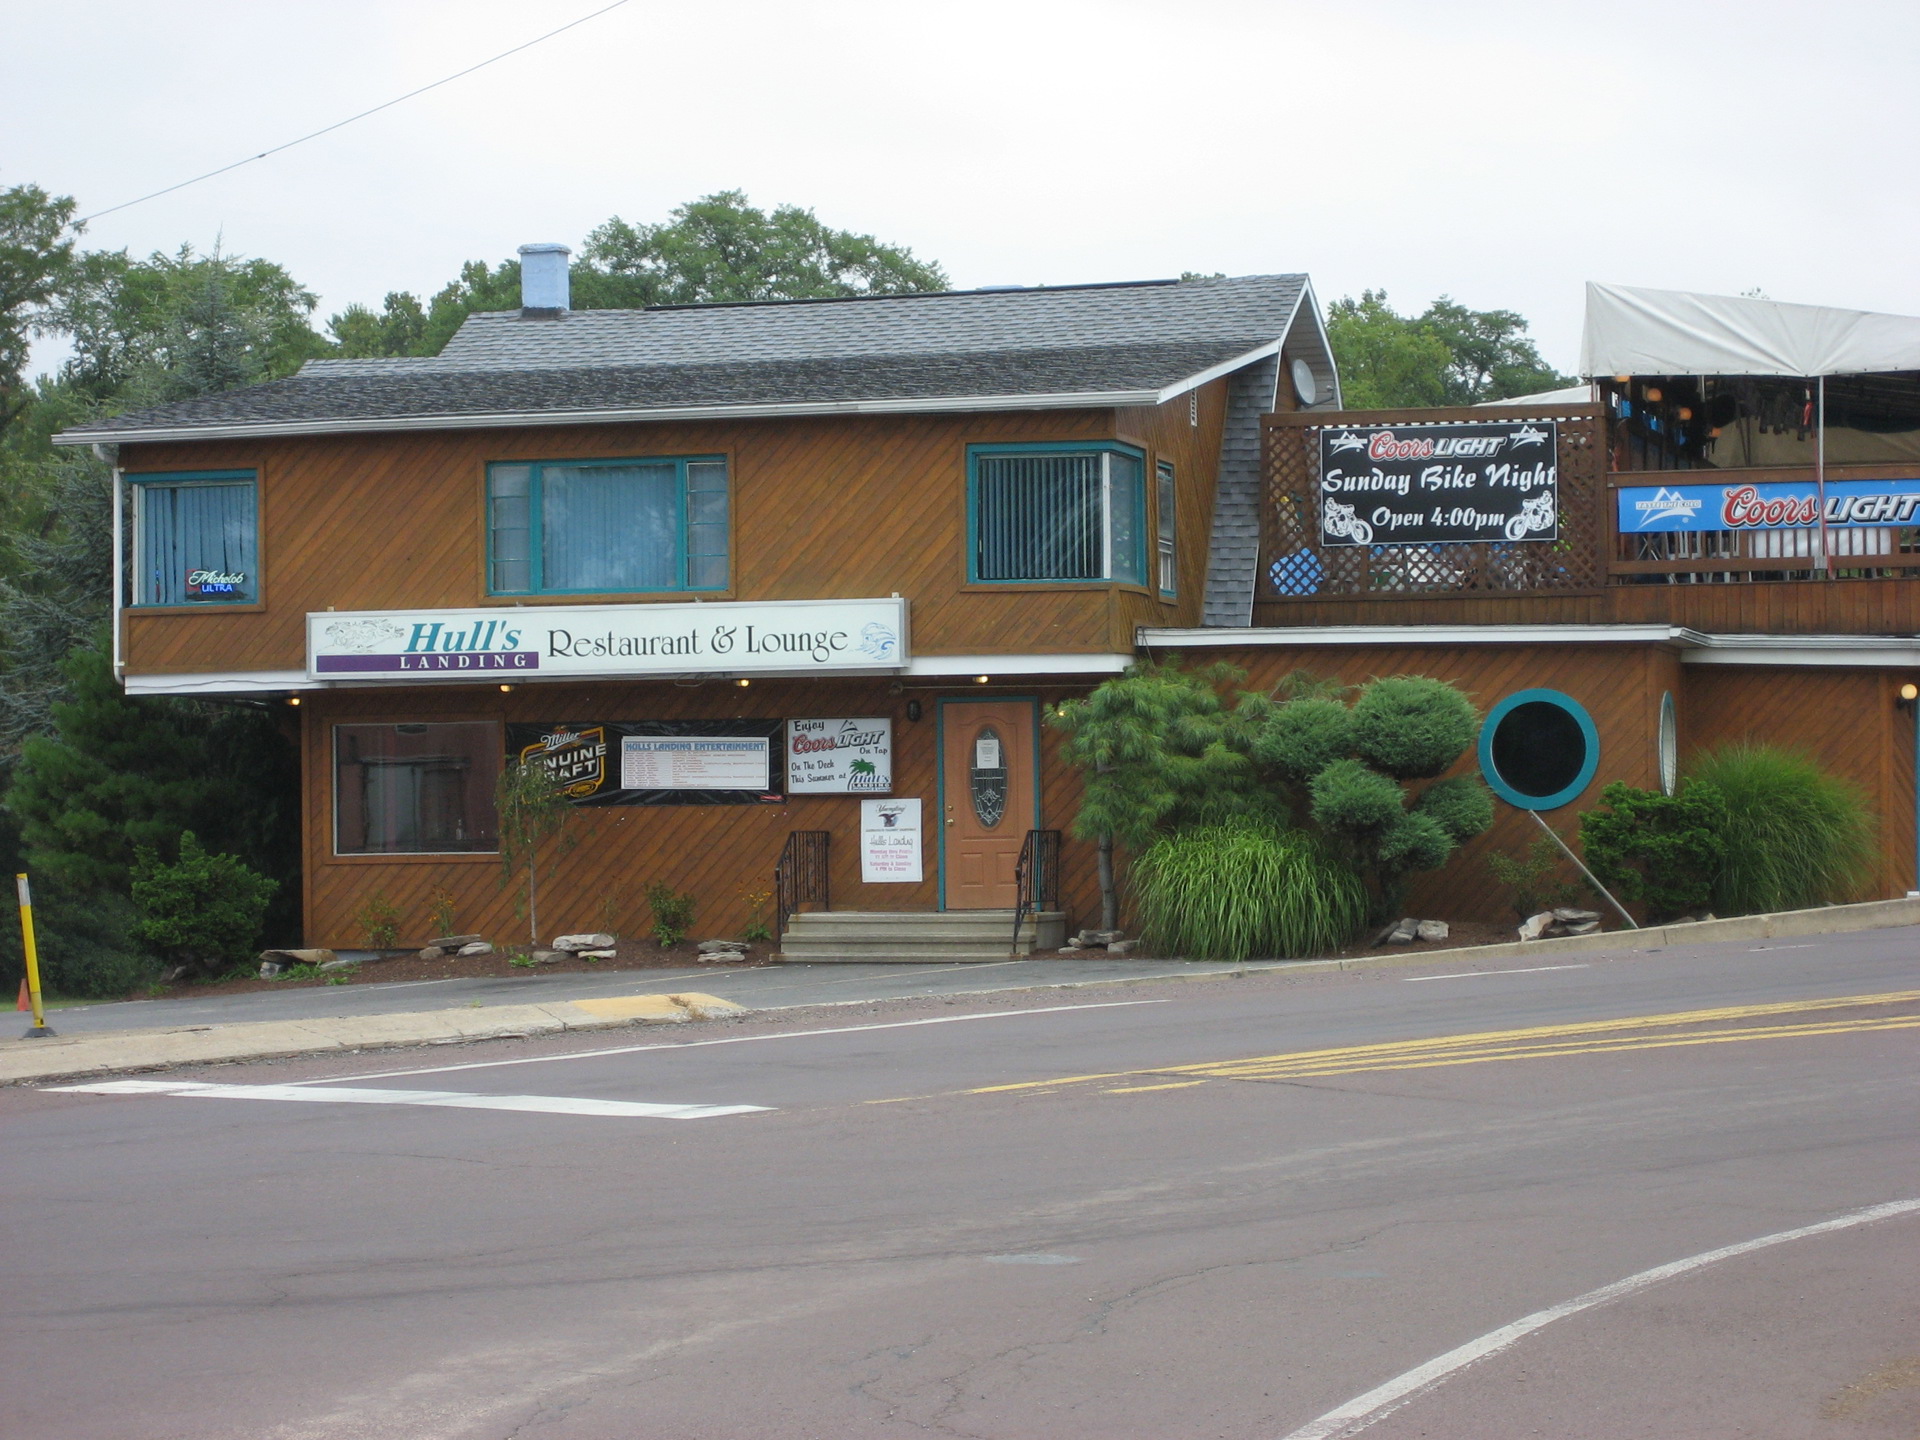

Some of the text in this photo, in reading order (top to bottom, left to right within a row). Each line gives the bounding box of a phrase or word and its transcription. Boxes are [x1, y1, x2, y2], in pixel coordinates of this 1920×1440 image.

[1368, 430, 1507, 461] Coors LIGHT
[1322, 461, 1557, 495] Sunday Bike Night
[1722, 484, 1920, 529] Coors LIGHT
[1372, 506, 1505, 531] Open 4:00pm
[189, 570, 244, 585] Michelob
[202, 584, 232, 592] ULTRA
[403, 620, 522, 653] Hull's
[547, 625, 848, 662] Restaurant & Lounge
[400, 653, 527, 669] LANDING
[794, 720, 825, 732] Enjoy
[540, 732, 580, 751] Miller
[793, 730, 885, 755] Coors LIGHT
[874, 747, 888, 755] Tap
[791, 759, 835, 771] On The Deck
[791, 775, 804, 783] This
[807, 773, 835, 783] Summer
